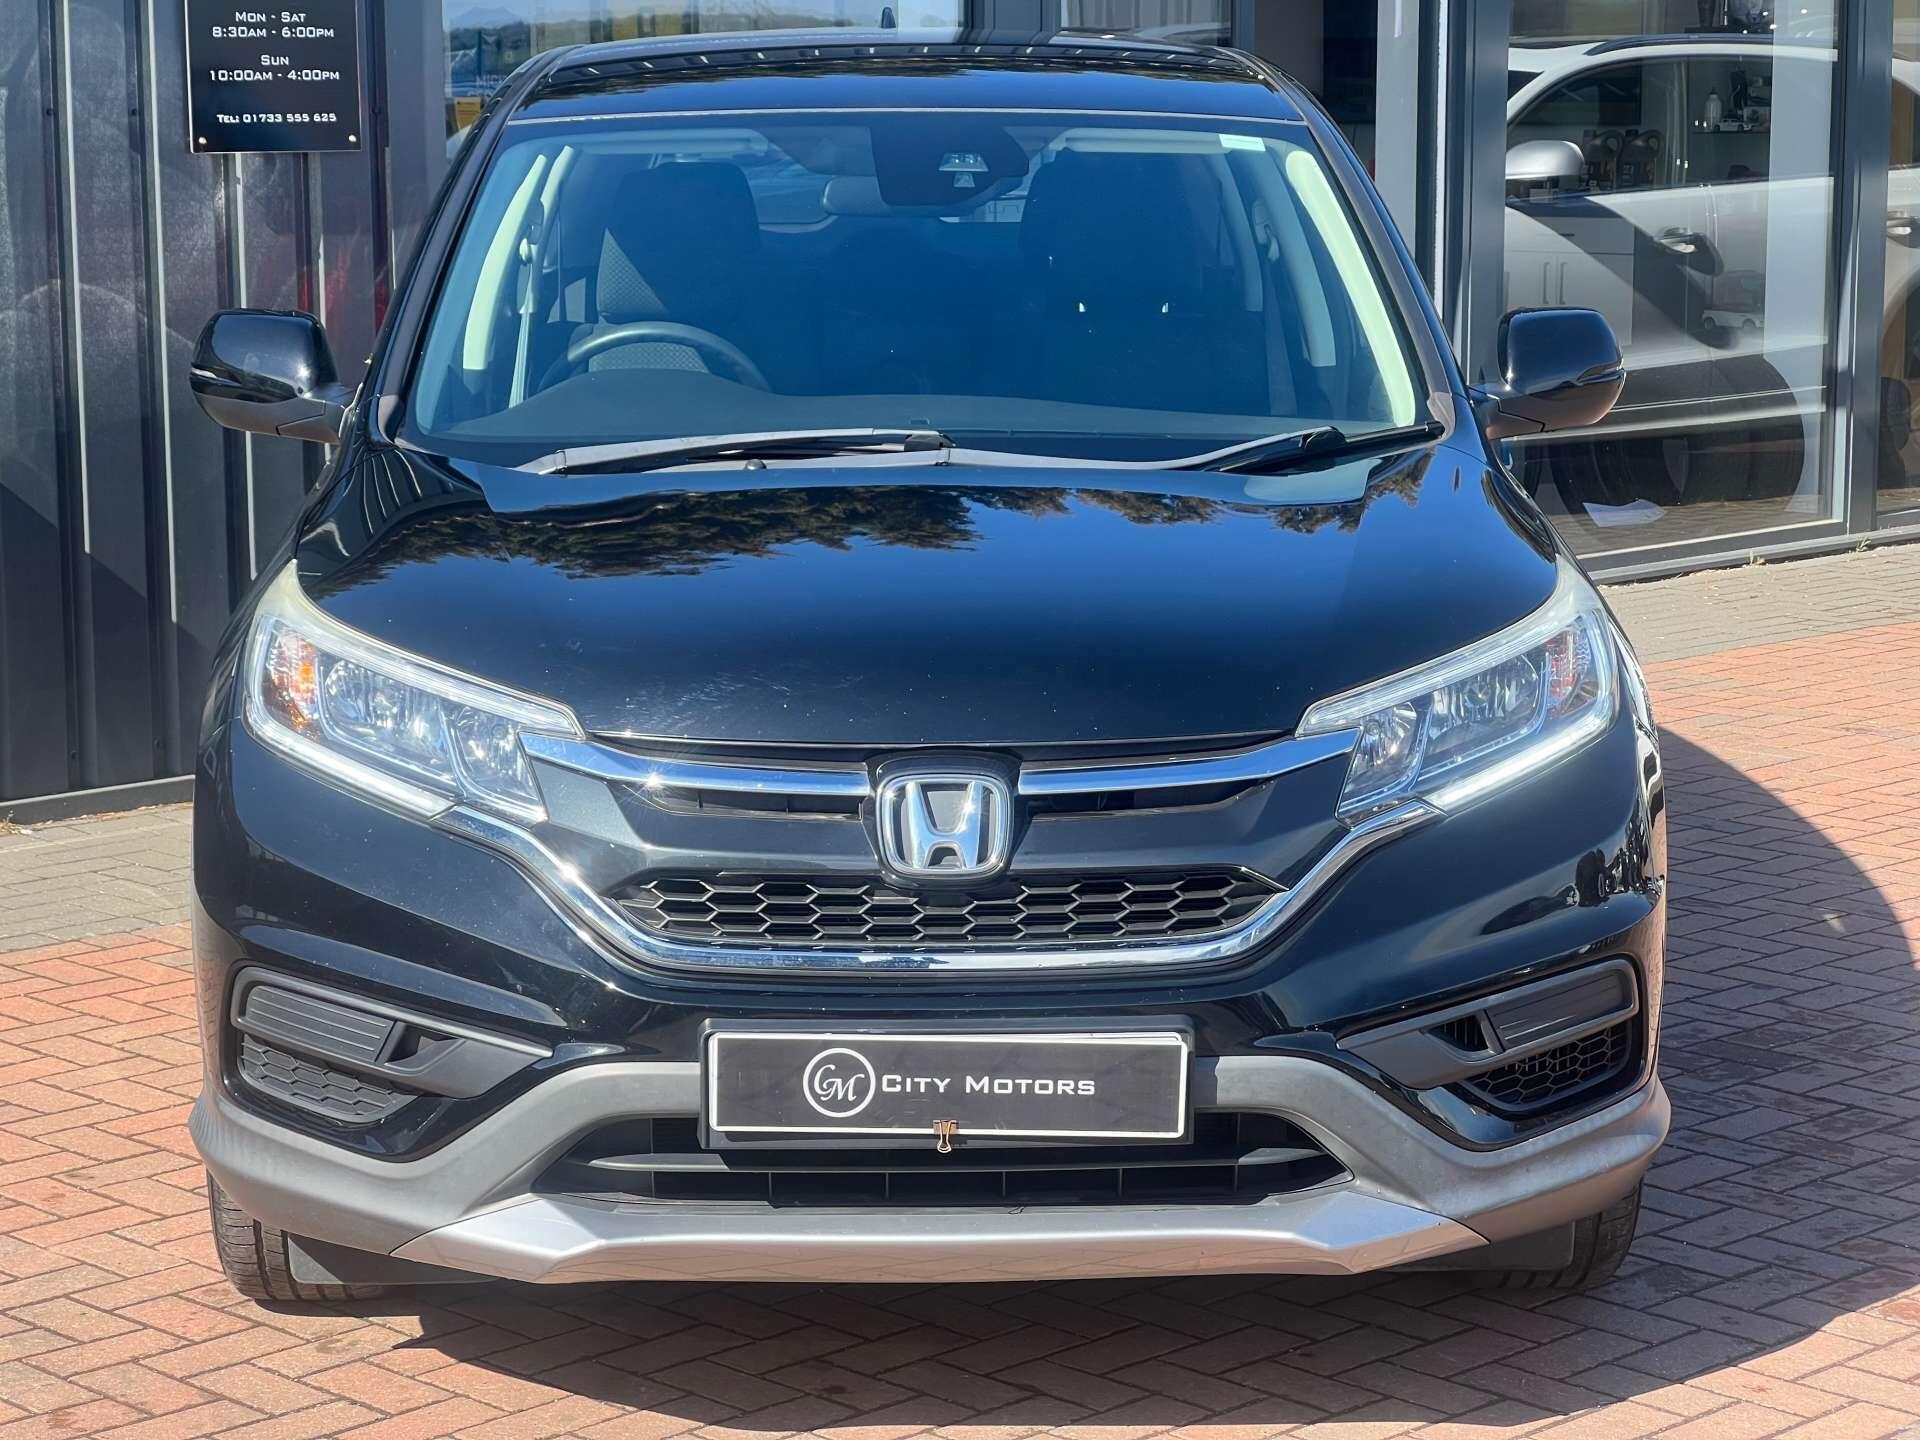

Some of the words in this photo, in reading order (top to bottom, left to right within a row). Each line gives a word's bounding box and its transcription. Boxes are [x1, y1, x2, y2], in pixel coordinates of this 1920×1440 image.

[212, 26, 267, 38] 8:30AM
[281, 26, 335, 38] 6:00PM
[209, 69, 273, 82] 10:00AM
[286, 69, 340, 81] 4:00PM
[242, 113, 283, 123] 01733
[286, 113, 311, 123] 555
[313, 112, 337, 123] 625
[882, 1075, 951, 1092] CITY
[966, 1076, 1095, 1095] MOTORS
